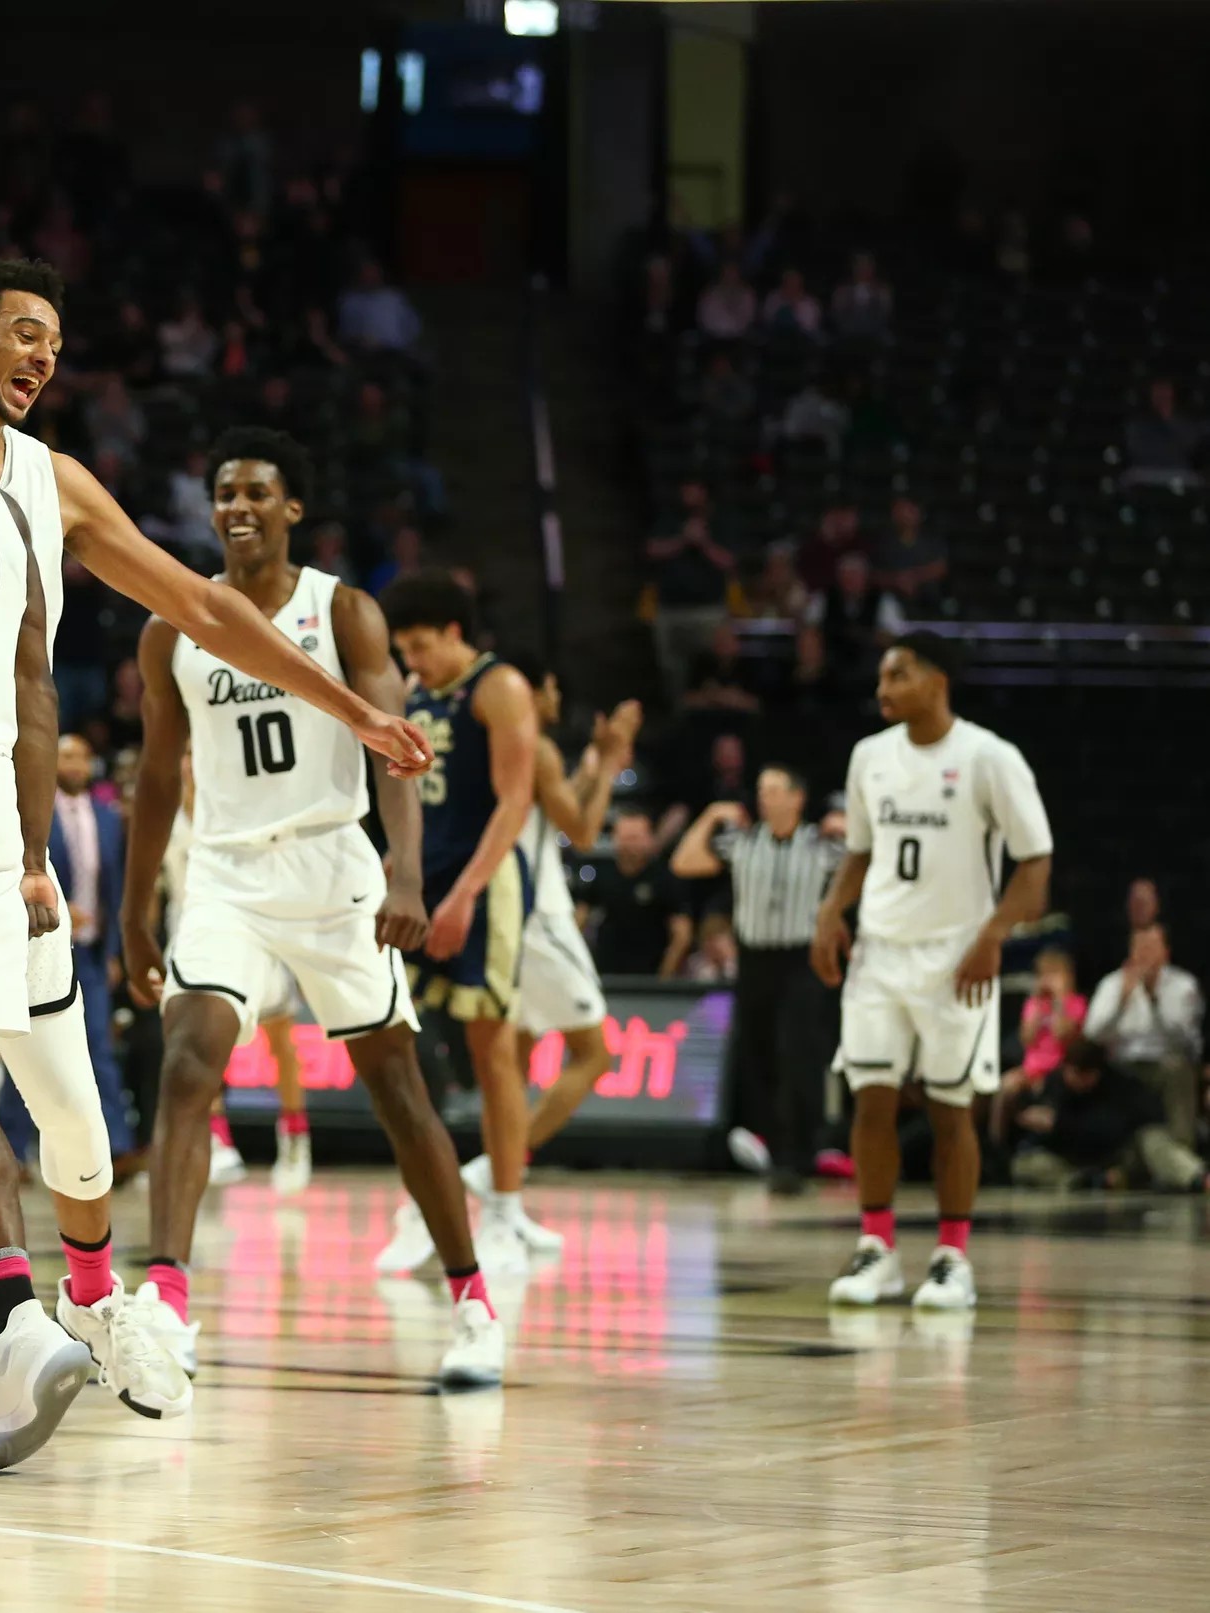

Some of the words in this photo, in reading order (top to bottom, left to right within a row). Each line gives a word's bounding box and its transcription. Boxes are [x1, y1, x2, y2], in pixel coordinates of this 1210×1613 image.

[208, 669, 294, 705] Deaco
[237, 710, 296, 776] 10
[898, 837, 920, 881] 0
